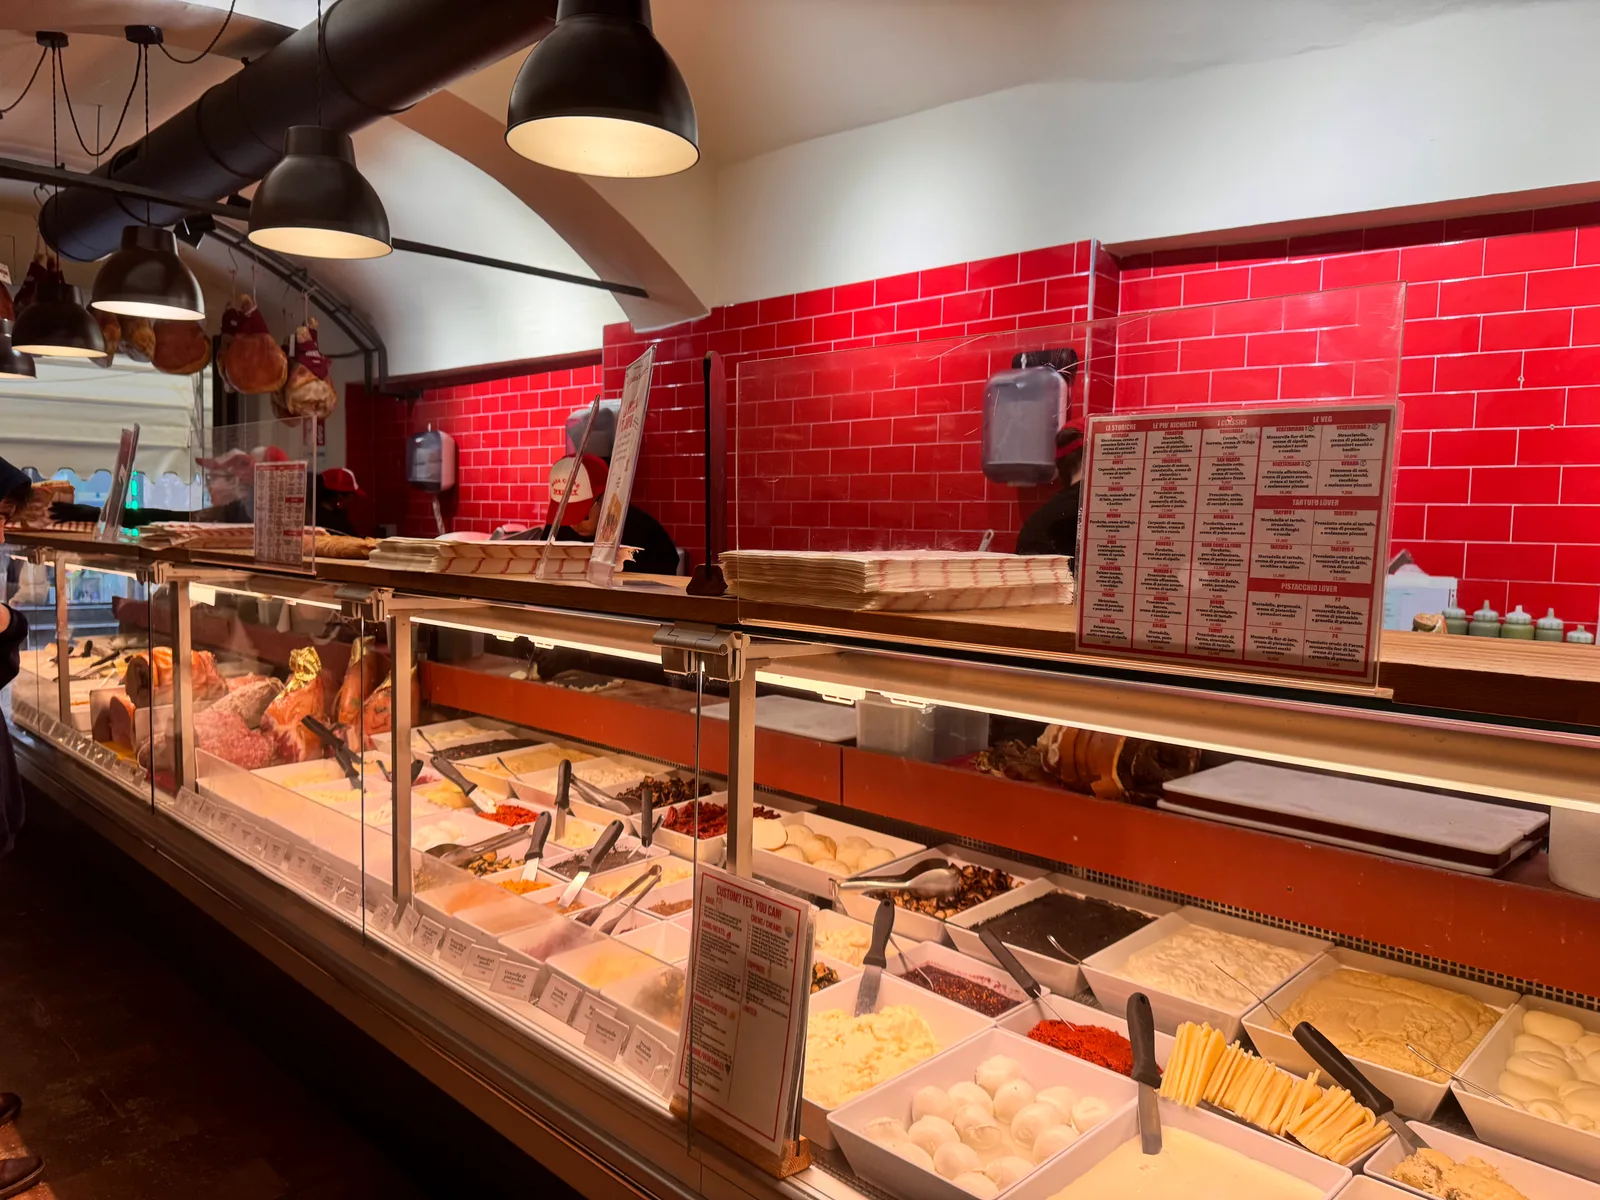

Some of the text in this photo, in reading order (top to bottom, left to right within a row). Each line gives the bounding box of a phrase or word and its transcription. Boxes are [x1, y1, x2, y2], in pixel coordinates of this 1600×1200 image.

[1282, 583, 1317, 591] PISTACCHIO
[717, 885, 782, 920] CUSTOM? YES, YOU CAN!
